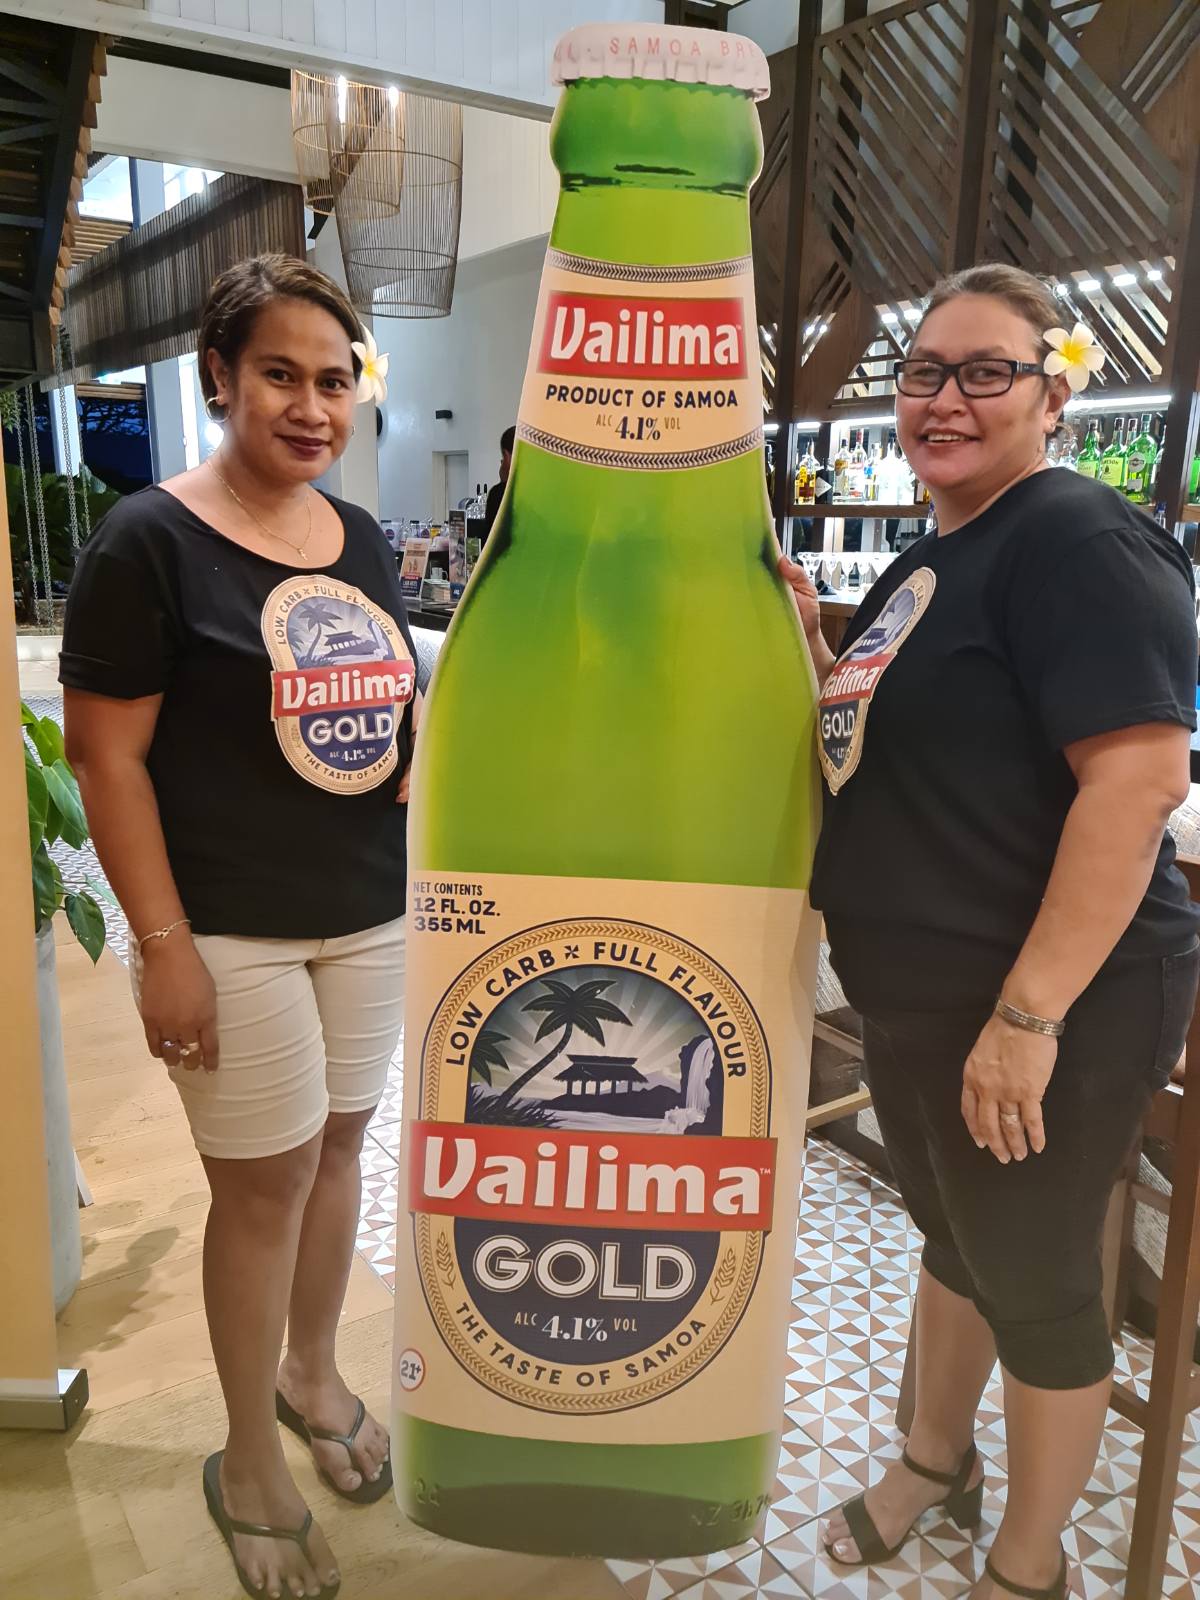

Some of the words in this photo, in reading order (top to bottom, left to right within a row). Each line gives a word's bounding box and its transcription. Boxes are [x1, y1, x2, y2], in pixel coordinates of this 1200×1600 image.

[609, 37, 702, 56] SAMOA
[550, 306, 740, 365] Vailima
[546, 384, 633, 407] PRODUCT
[642, 390, 666, 408] OF
[674, 390, 738, 408] SAMOA
[596, 414, 612, 427] ALC
[614, 416, 661, 441] 4.1%
[664, 417, 681, 430] VOL
[279, 591, 302, 613] CARB
[314, 585, 341, 598] FULL
[346, 595, 393, 636] FLAVOUR
[275, 616, 286, 645] LOW
[282, 669, 411, 709] Vailima
[307, 712, 393, 745] GOLD
[822, 709, 855, 739] GOLD
[303, 753, 320, 770] THE
[323, 767, 353, 781] TASTE
[357, 772, 369, 780] OF
[413, 881, 431, 893] NET
[434, 883, 483, 896] CONTENTS
[413, 897, 436, 913] 12
[441, 898, 466, 915] FL.
[469, 900, 501, 917] OZ.
[414, 916, 453, 933] 355
[456, 918, 486, 935] ML
[445, 1002, 483, 1066] LOW
[486, 949, 556, 997] CARB
[593, 941, 658, 972] FULL
[668, 965, 746, 1078] FLAVOUR
[422, 1136, 760, 1215] Vailima
[473, 1235, 697, 1302] GOLD
[514, 1312, 538, 1326] ALC
[541, 1315, 608, 1342] 4.1%
[613, 1318, 638, 1332] VOL
[456, 1302, 489, 1344] THE
[489, 1342, 562, 1385] TASTE
[576, 1369, 611, 1387] OF
[625, 1319, 706, 1377] SAMOA
[401, 1360, 421, 1380] 21+
